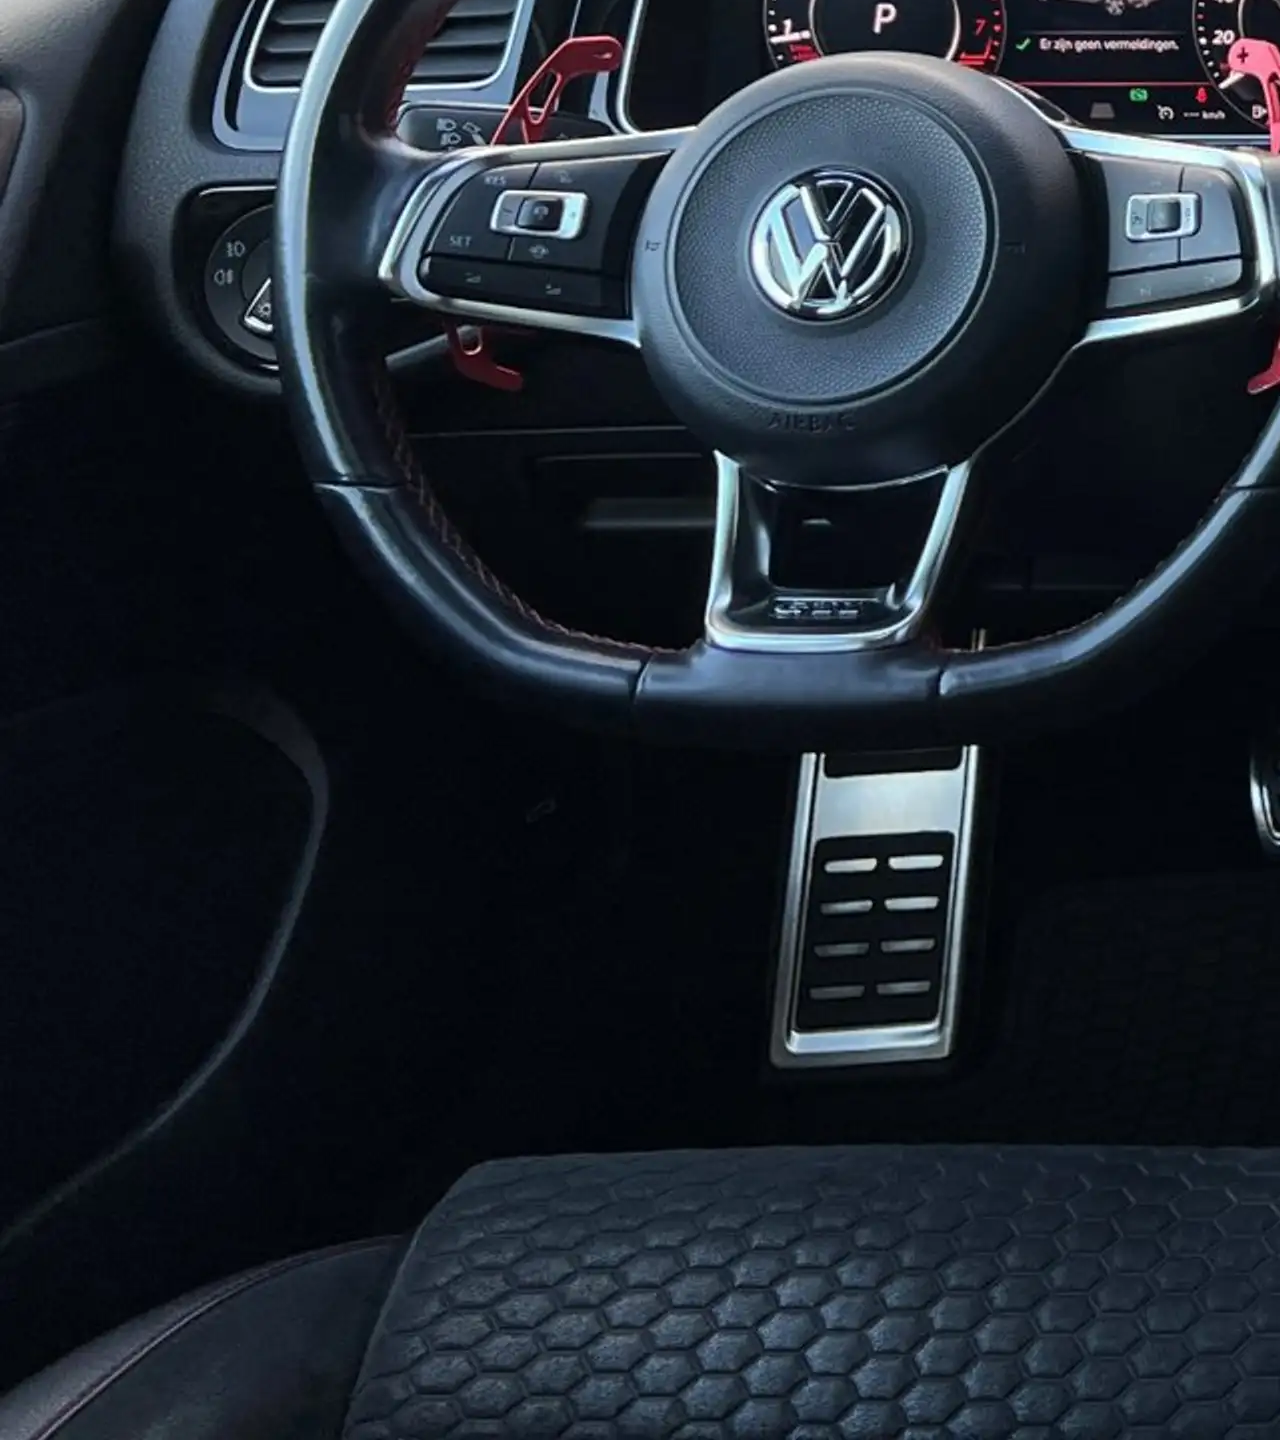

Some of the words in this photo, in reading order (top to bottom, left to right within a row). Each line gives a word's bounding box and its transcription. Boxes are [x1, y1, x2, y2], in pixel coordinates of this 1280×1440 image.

[871, 1, 898, 35] P
[974, 18, 987, 36] 7
[1212, 29, 1236, 46] 20
[1074, 39, 1102, 54] geen
